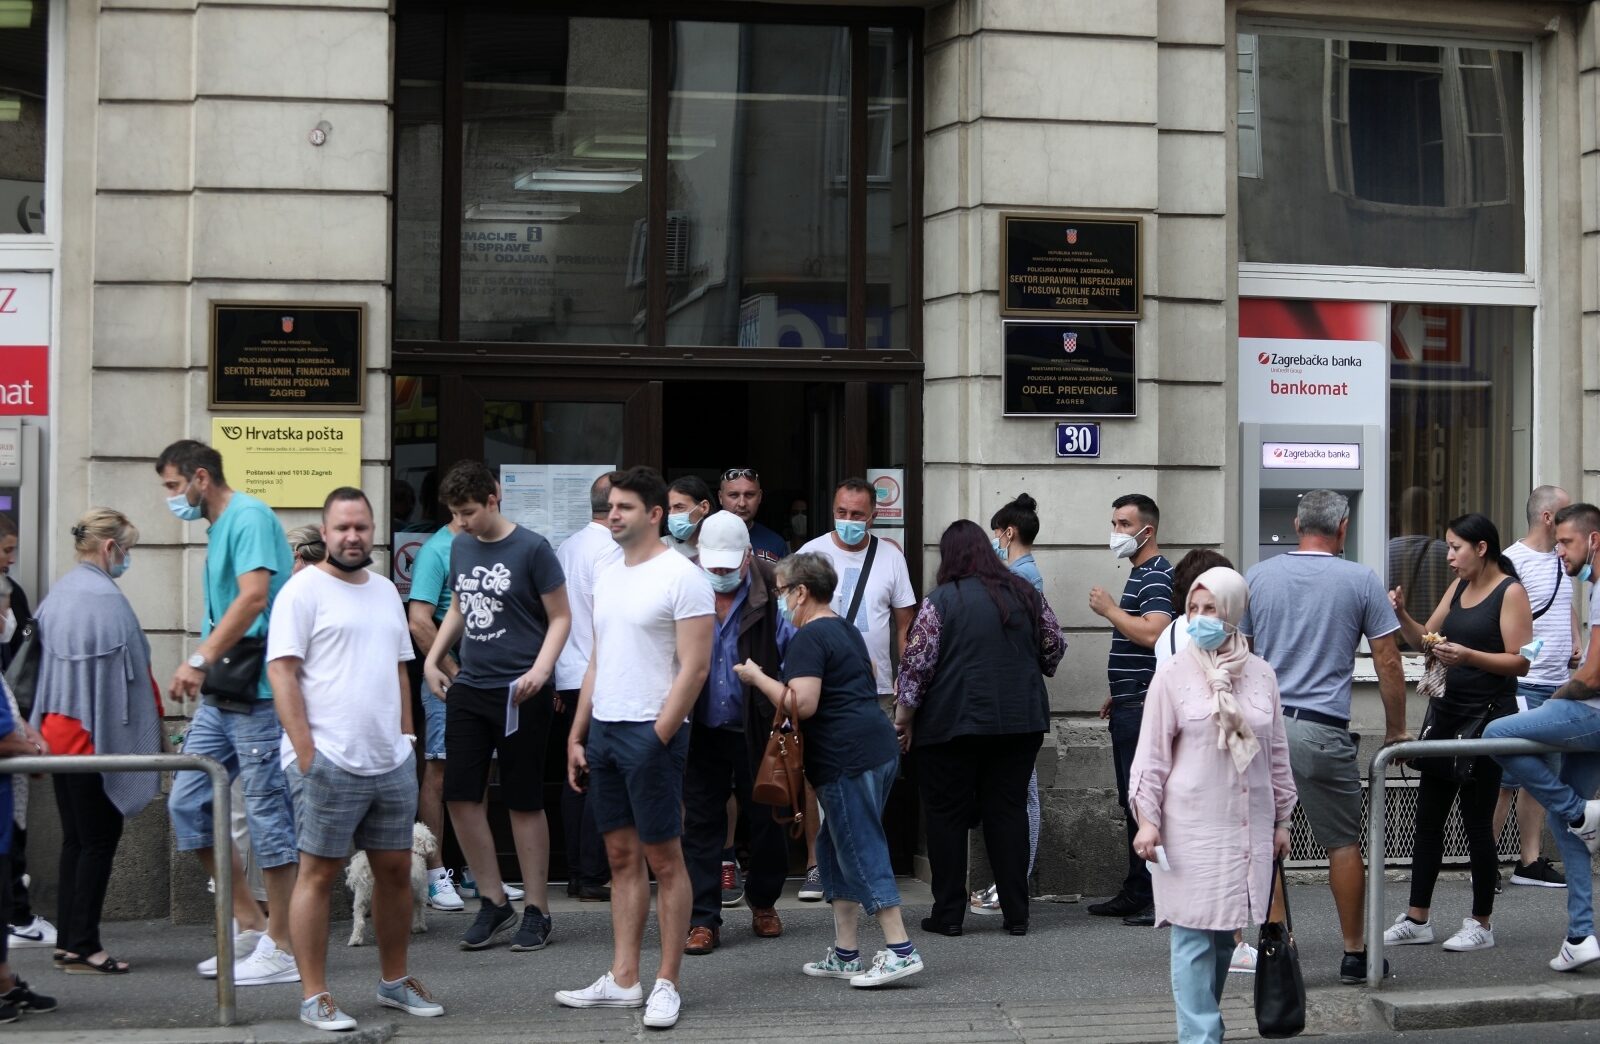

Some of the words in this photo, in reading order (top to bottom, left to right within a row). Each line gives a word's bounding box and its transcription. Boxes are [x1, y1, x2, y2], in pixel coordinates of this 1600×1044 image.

[473, 243, 530, 252] ISPRAVE
[495, 254, 548, 264] ODJAVA
[1010, 275, 1038, 283] SEKTOR
[1039, 275, 1079, 286] UPRAVNIH,
[1080, 278, 1133, 286] INSPEKCIJSKIH
[1023, 286, 1027, 294] I
[1027, 286, 1060, 295] POSLOVA
[1062, 287, 1090, 295] CIVILNE
[1091, 286, 1120, 296] ZAŠTITE
[1055, 297, 1089, 305] ZAGREB
[297, 356, 335, 364] ZAGREBAČKA
[1271, 353, 1329, 368] Zagrebačka
[1332, 355, 1362, 367] banka
[224, 366, 255, 375] SEKTOR
[257, 367, 294, 376] PRAVNIH,
[296, 367, 350, 376] FINANCIJSKIH
[244, 378, 248, 386] I
[250, 376, 292, 387] TEHNIČKIH
[293, 378, 330, 387] POSLOVA
[270, 389, 306, 397] ZAGREB
[1022, 385, 1054, 395] ODJEL
[1058, 386, 1118, 395] PREVENCIJE
[1270, 379, 1348, 396] bankomat
[245, 426, 303, 440] Hrvatska
[306, 426, 344, 442] pošta
[1065, 426, 1092, 452] 30
[1283, 448, 1326, 460] Zagrebačka
[1328, 450, 1350, 459] banka
[455, 573, 480, 591] Jam
[472, 562, 511, 596] The
[460, 591, 504, 629] Music
